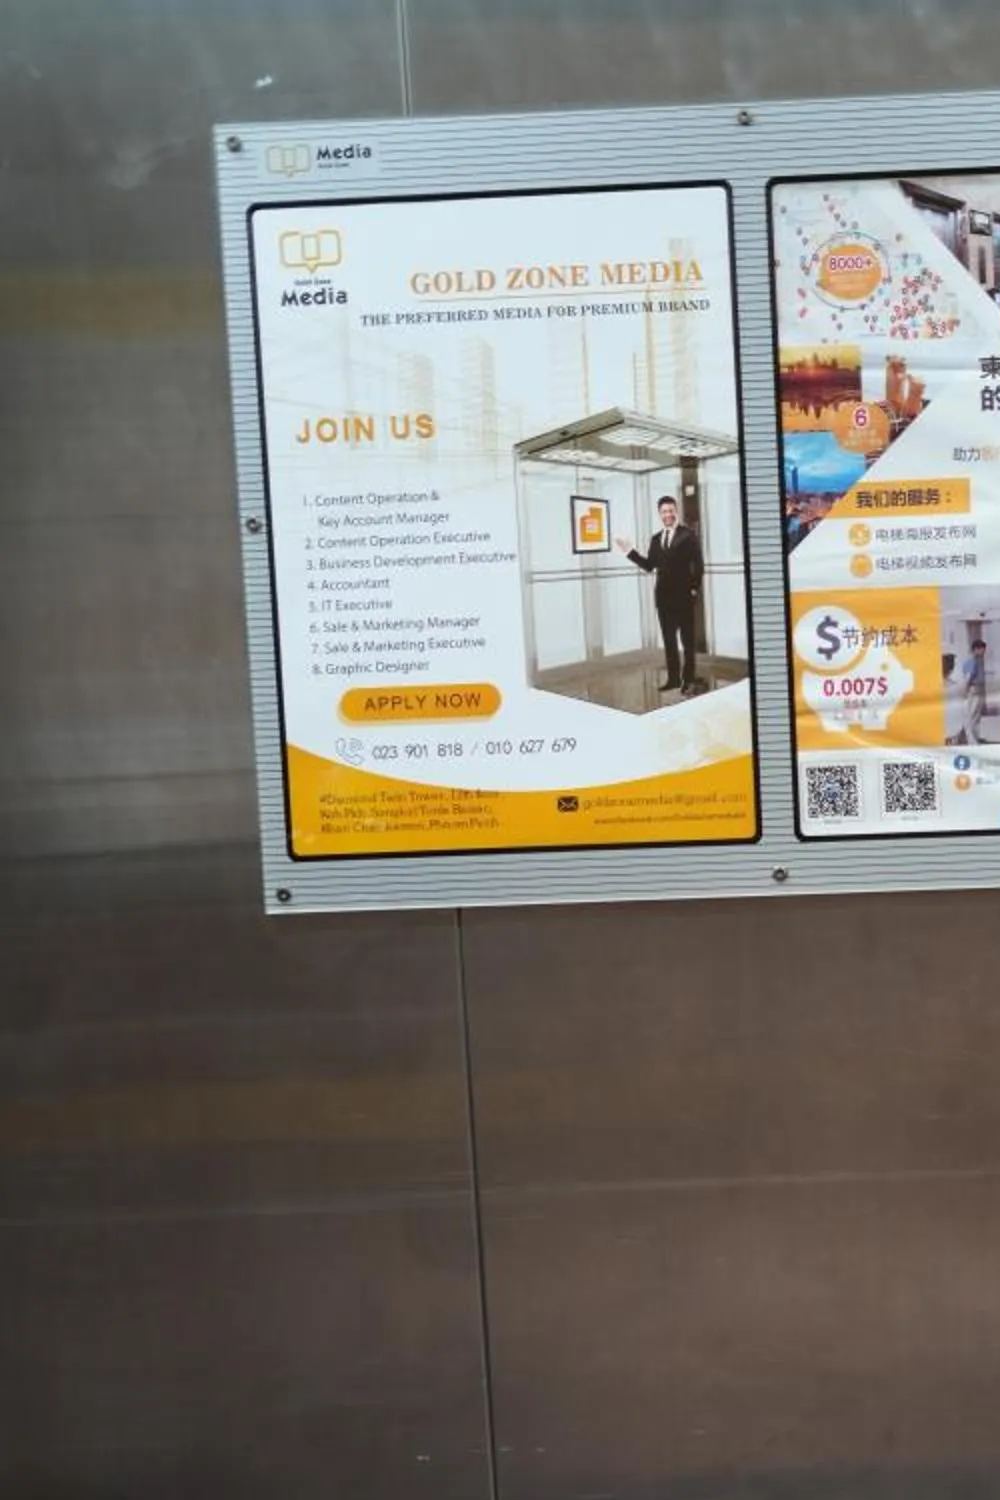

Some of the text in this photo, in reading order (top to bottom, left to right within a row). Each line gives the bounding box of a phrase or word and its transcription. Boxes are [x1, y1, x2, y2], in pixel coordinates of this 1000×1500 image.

[316, 143, 372, 160] Media
[829, 255, 872, 271] 8000+
[410, 259, 704, 295] GOLD ZONE MEDIA
[280, 287, 349, 306] Media
[360, 299, 711, 327] THE PREFERRED MEDIA FOR PREMIUM BRAND
[855, 407, 867, 427] 6
[296, 413, 435, 443] JOIN US
[315, 494, 363, 507] Content
[366, 491, 428, 506] Operation
[318, 513, 449, 528] Key Account Manager
[318, 537, 368, 549] Content
[369, 534, 431, 547] Operation
[433, 531, 491, 544] Executive
[320, 557, 370, 570] Business
[373, 554, 456, 568] Development
[459, 551, 516, 564] Executive
[321, 577, 390, 591] Accountant
[321, 599, 333, 612] IT
[335, 599, 393, 612] Executive
[323, 621, 348, 633] Sale
[362, 618, 425, 633] Marketing
[427, 616, 481, 631] Manager
[841, 623, 919, 649] 节约成本
[323, 641, 349, 655] Sale
[363, 639, 425, 653] Marketing
[427, 637, 486, 650] Executive
[325, 662, 373, 677] Graphic
[375, 660, 430, 674] Designer
[364, 692, 482, 712] APPLY NOW
[371, 745, 399, 760] 023
[404, 743, 429, 759] 901
[437, 743, 464, 758] 818
[485, 740, 513, 756] 010
[519, 738, 545, 755] 627
[551, 737, 578, 754] 679
